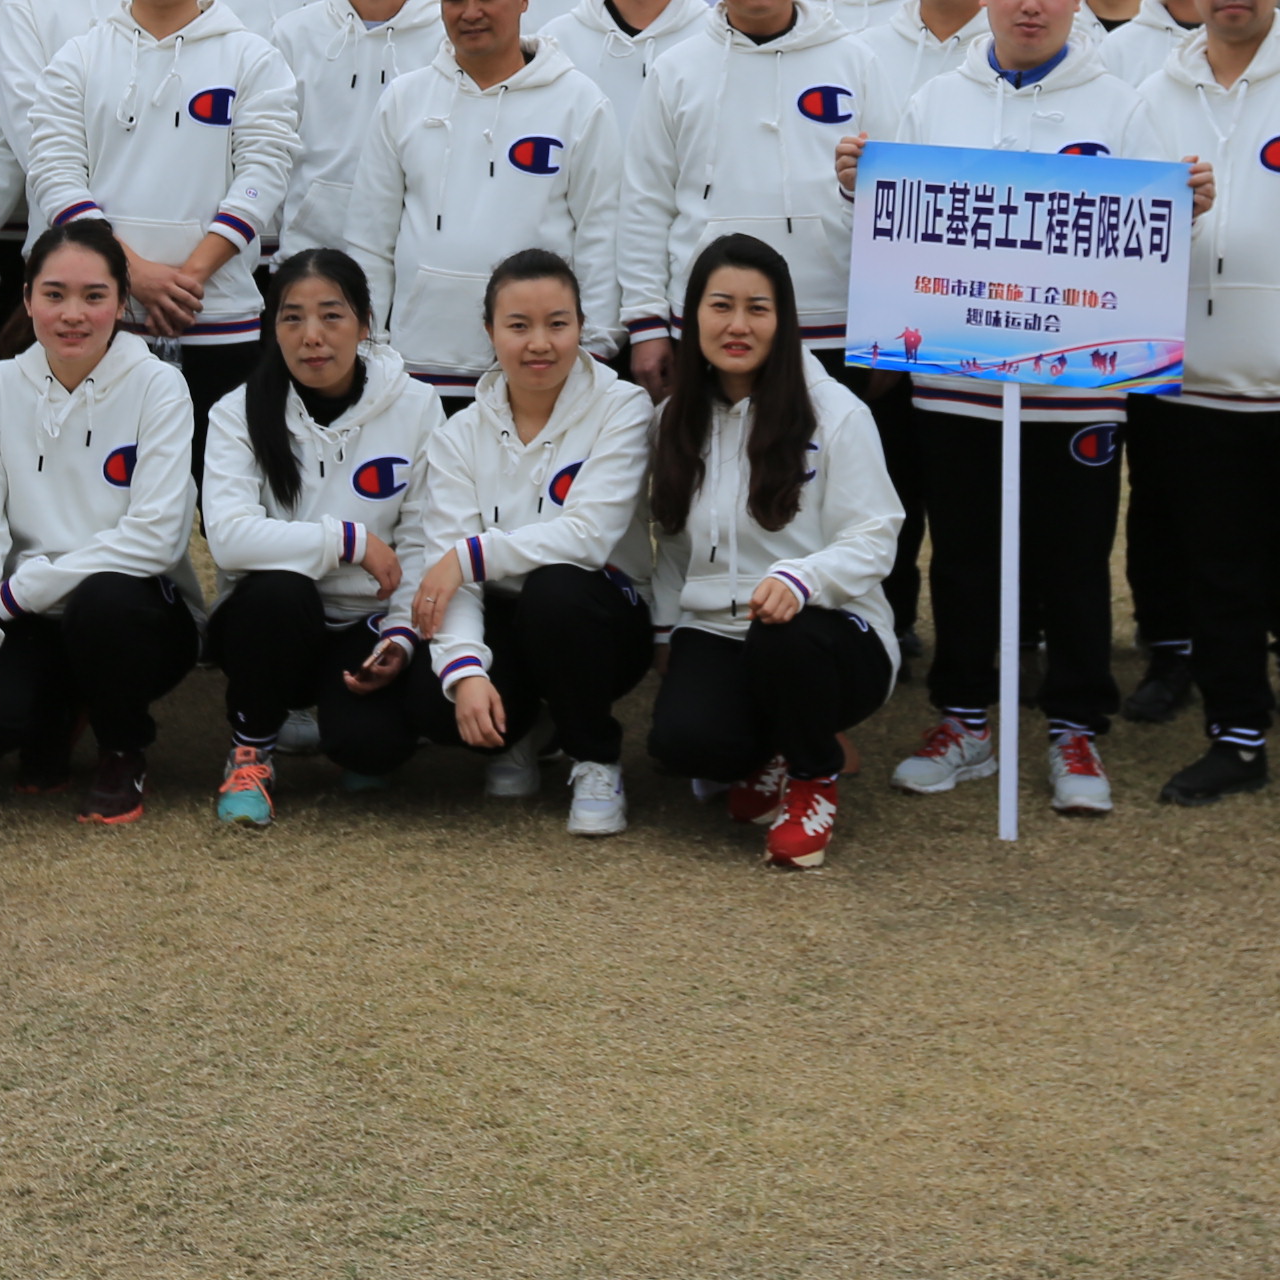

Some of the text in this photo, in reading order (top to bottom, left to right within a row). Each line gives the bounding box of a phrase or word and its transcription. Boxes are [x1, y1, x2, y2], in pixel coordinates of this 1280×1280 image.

[872, 178, 1173, 264] 四川正基岩土工程有限公司
[914, 275, 1118, 311] 绵阳市建筑施工企业协会
[966, 307, 1062, 333] 趣味运动会
